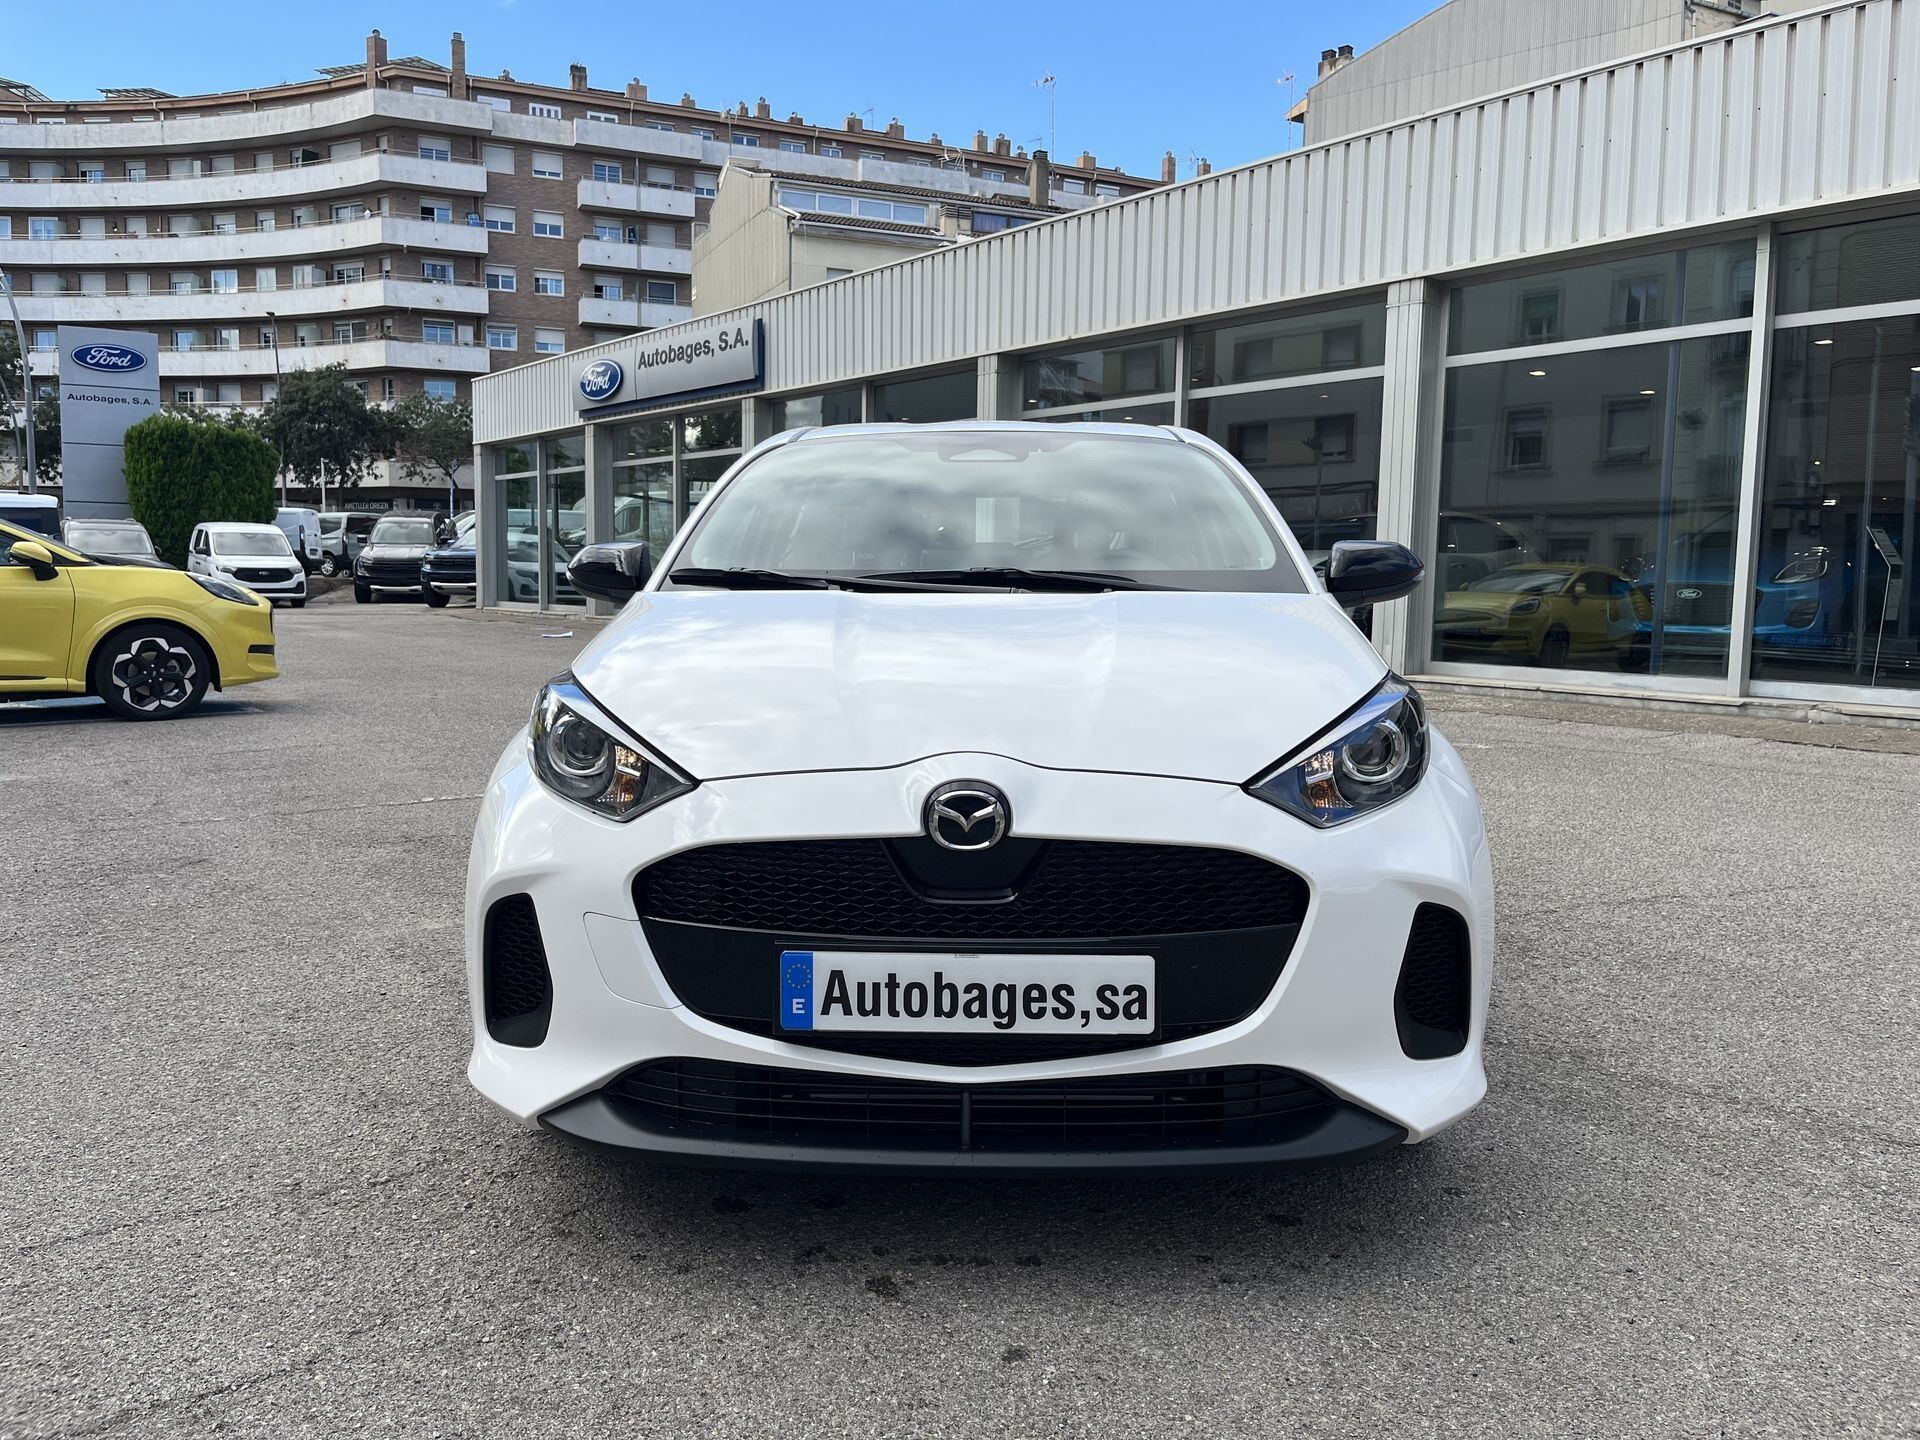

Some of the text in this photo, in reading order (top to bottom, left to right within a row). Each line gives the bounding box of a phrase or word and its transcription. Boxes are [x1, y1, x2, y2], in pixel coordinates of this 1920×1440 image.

[86, 347, 132, 366] Ford
[637, 327, 749, 370] Autobages, S.A.
[585, 365, 611, 393] Ford
[67, 393, 154, 406] Autobages, S.A.
[792, 998, 805, 1014] E
[820, 969, 1148, 1030] Autobages,sa
